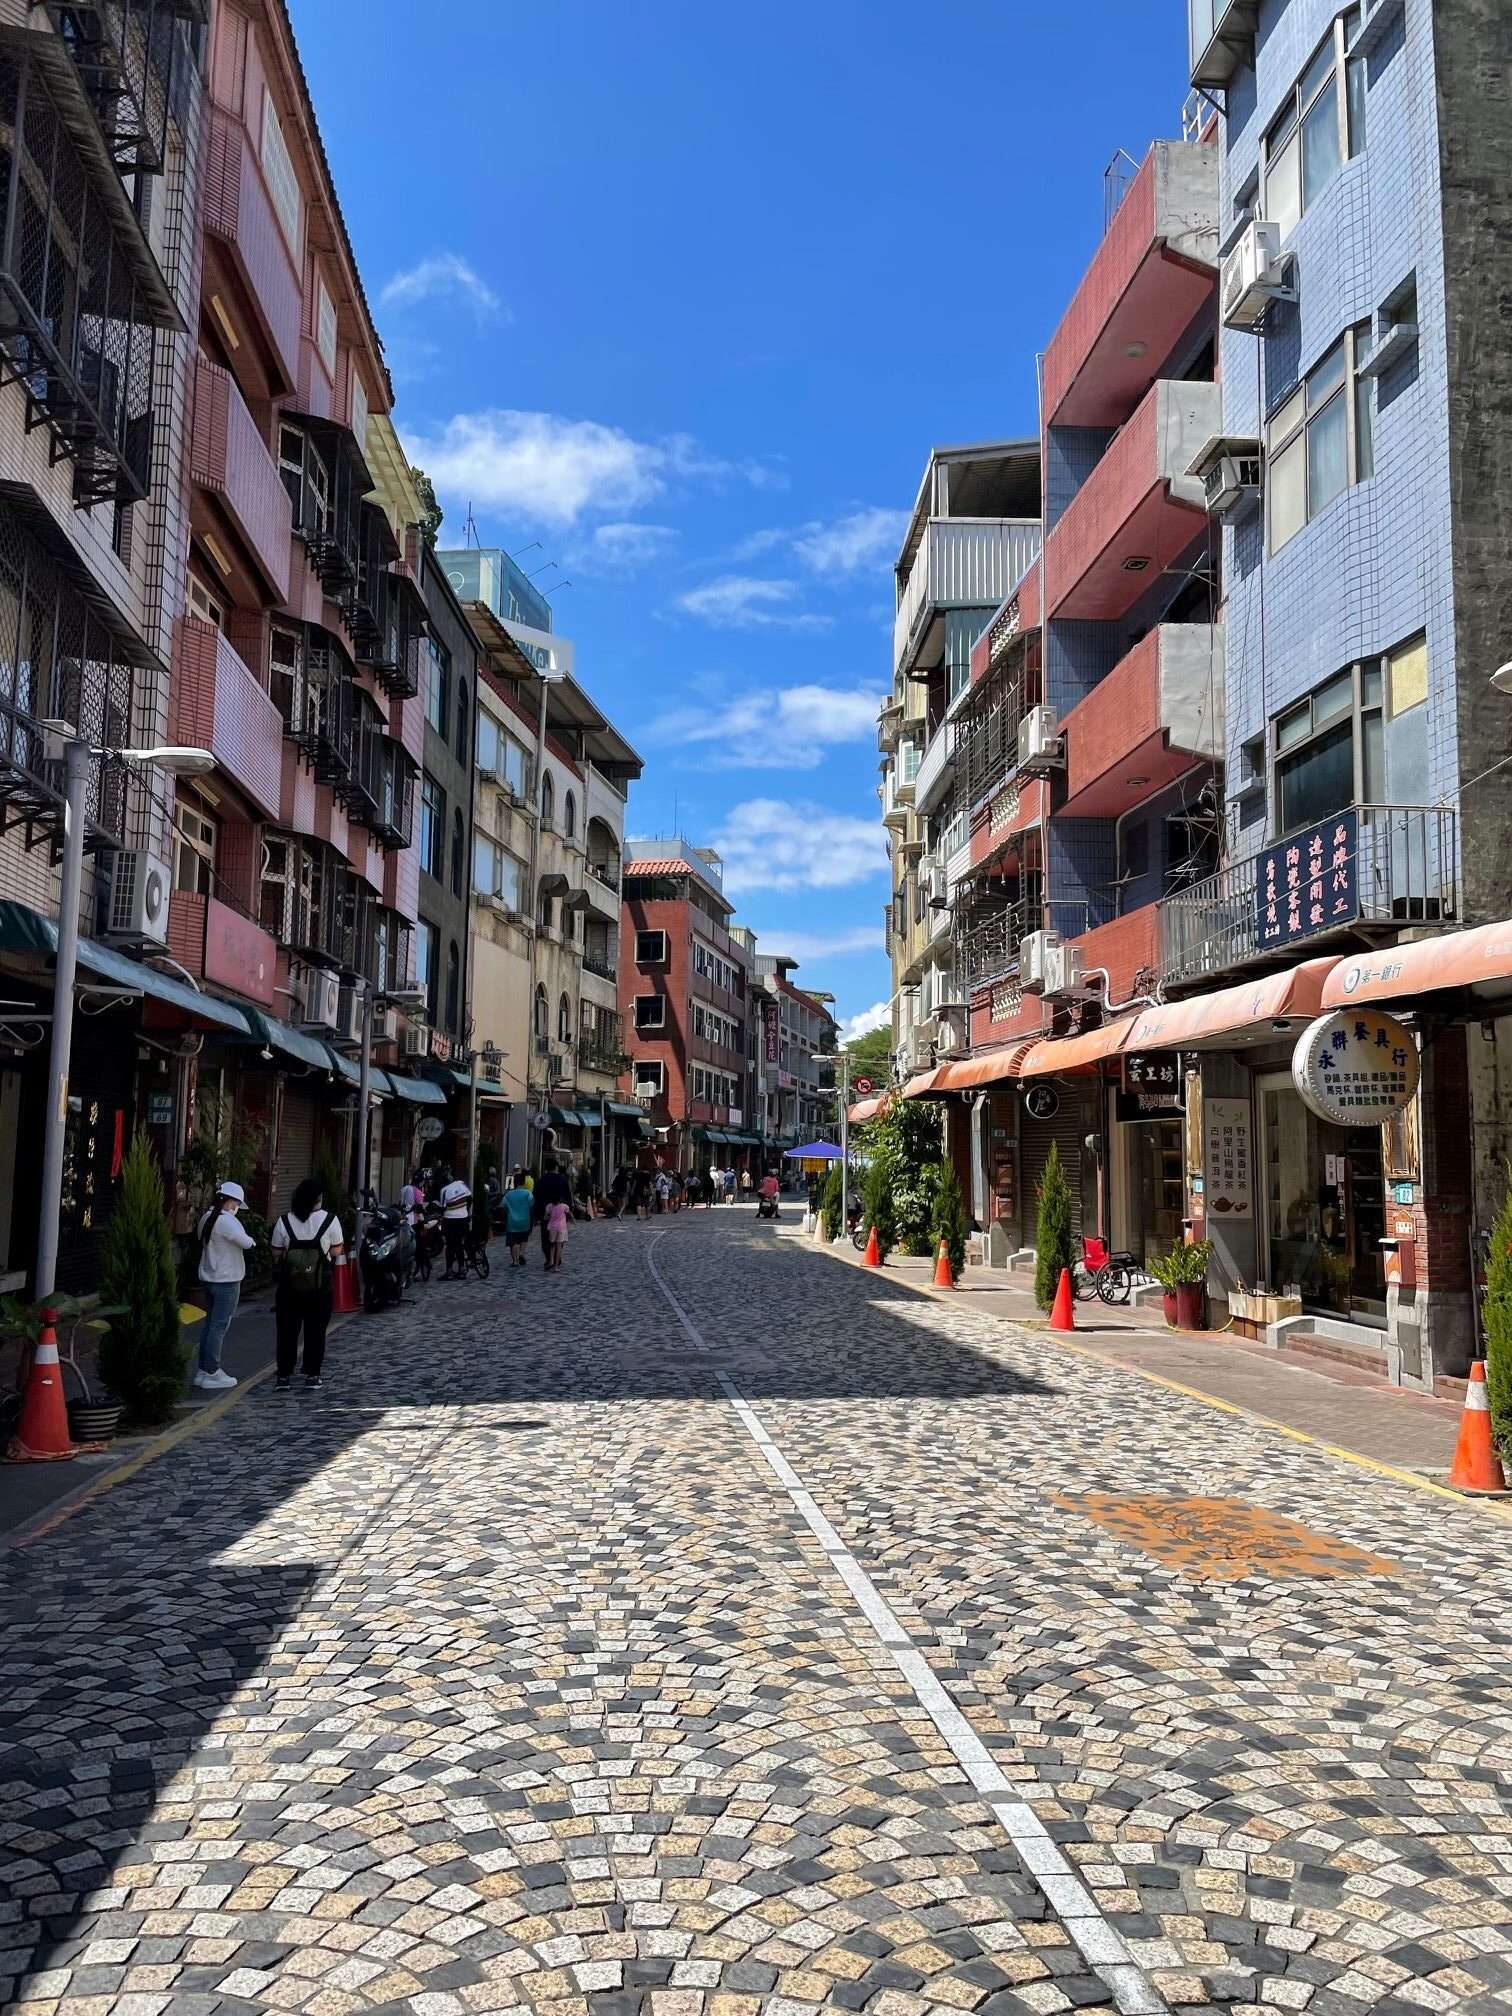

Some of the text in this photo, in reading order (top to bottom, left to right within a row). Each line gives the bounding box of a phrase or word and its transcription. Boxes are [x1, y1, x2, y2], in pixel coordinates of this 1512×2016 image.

[1309, 835, 1324, 925] 造型開發
[1333, 824, 1348, 915] 品牌代工
[1361, 966, 1402, 984] 第一銀行
